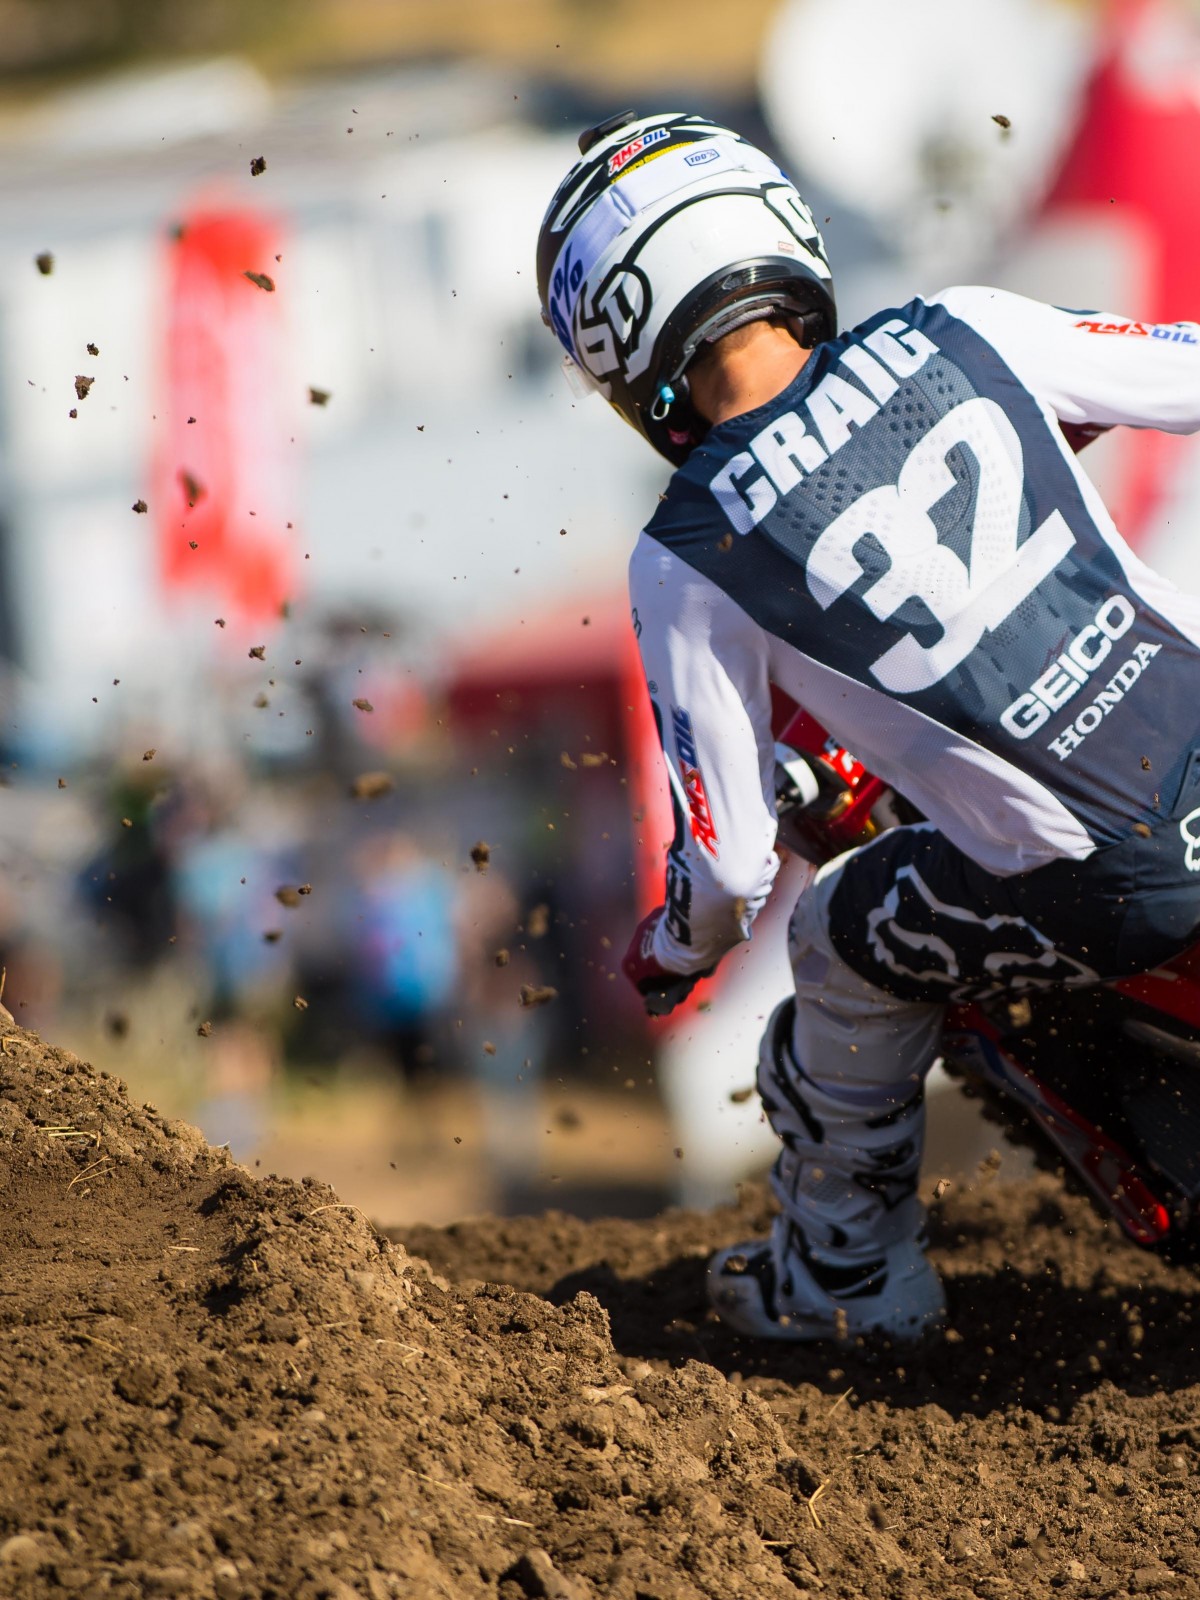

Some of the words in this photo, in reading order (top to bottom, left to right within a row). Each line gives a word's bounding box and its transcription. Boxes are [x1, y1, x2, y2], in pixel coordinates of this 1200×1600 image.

[609, 128, 668, 174] AMSOIL
[1073, 320, 1198, 344] AMSOIL
[709, 319, 940, 535] CRAIG
[806, 397, 1077, 694] 32
[1000, 594, 1136, 739] GEICO
[1047, 639, 1162, 761] HONDA
[671, 705, 719, 860] AMSOIL
